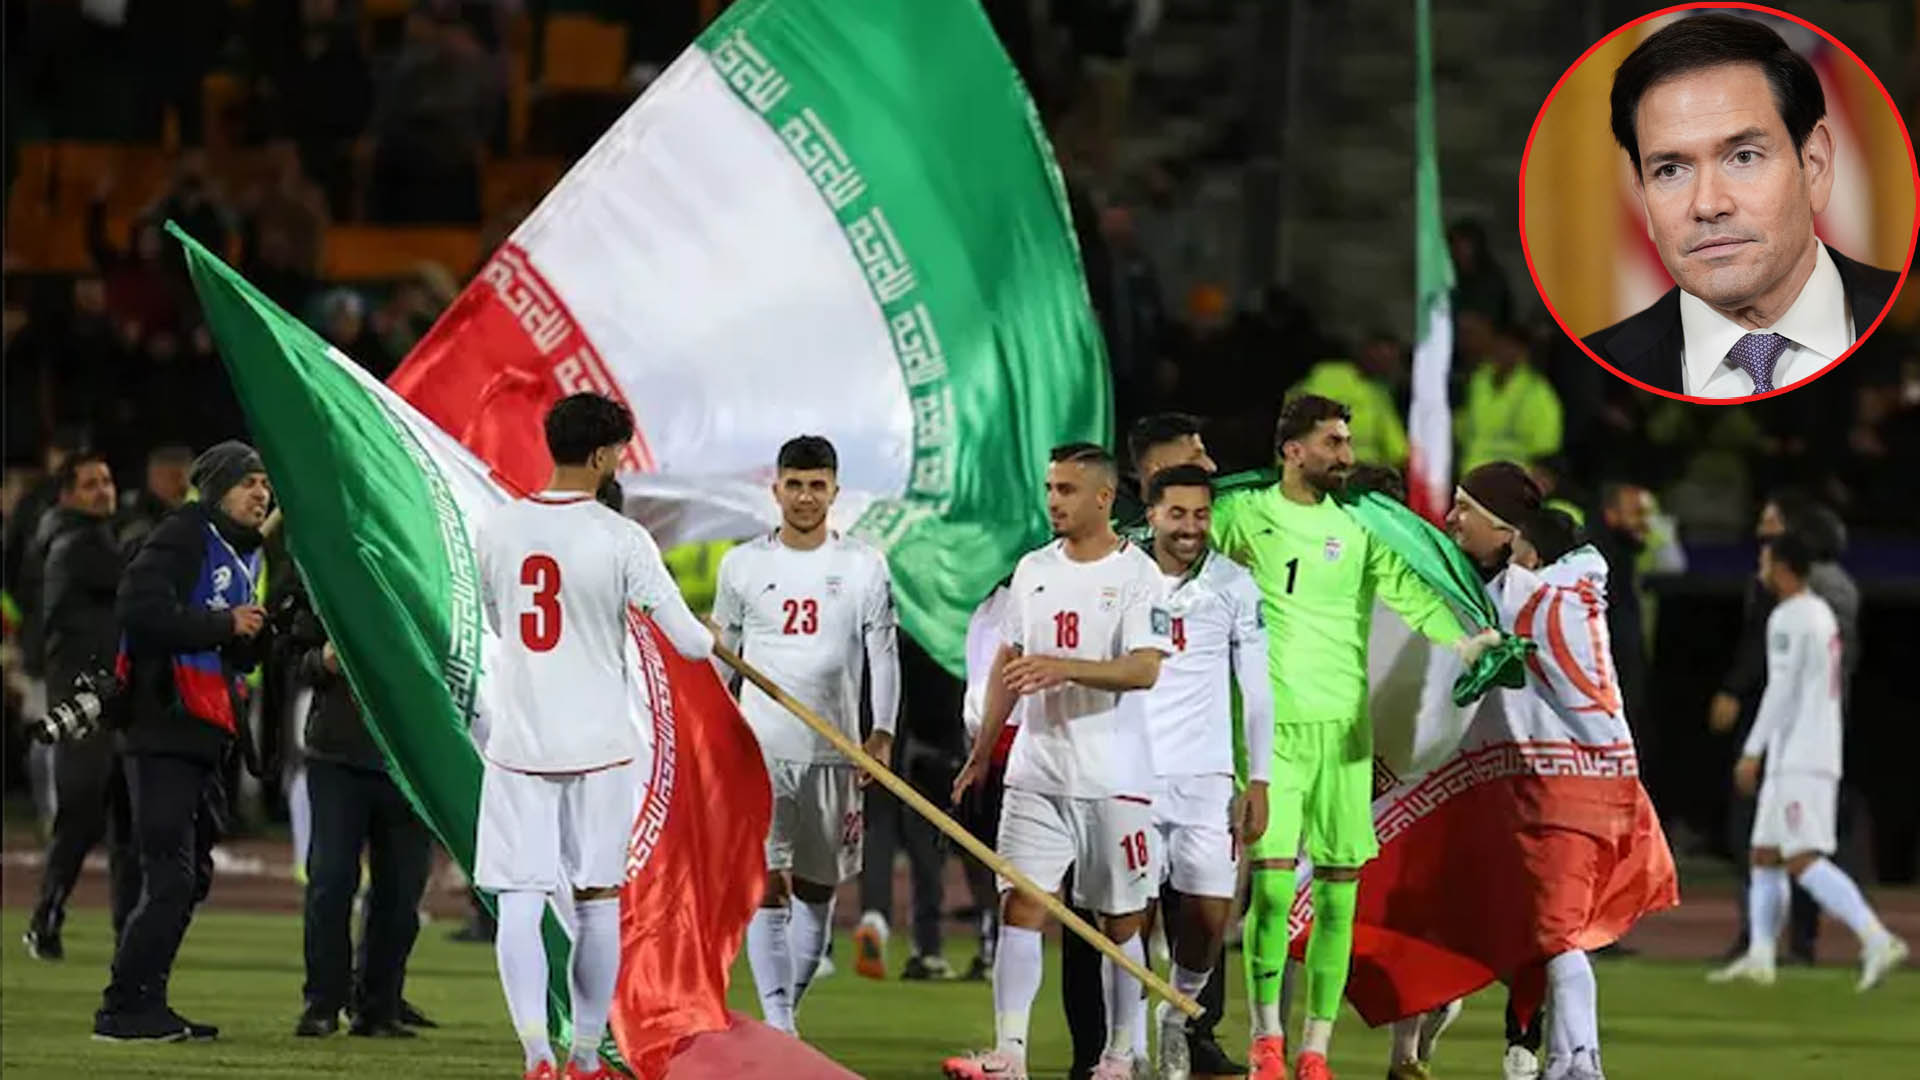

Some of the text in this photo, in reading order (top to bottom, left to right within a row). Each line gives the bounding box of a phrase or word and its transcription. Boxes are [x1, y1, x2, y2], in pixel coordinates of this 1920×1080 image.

[1285, 557, 1299, 594] 1
[520, 554, 561, 653] 3
[783, 599, 818, 635] 23
[1054, 610, 1079, 648] 18
[1120, 831, 1148, 870] 18
